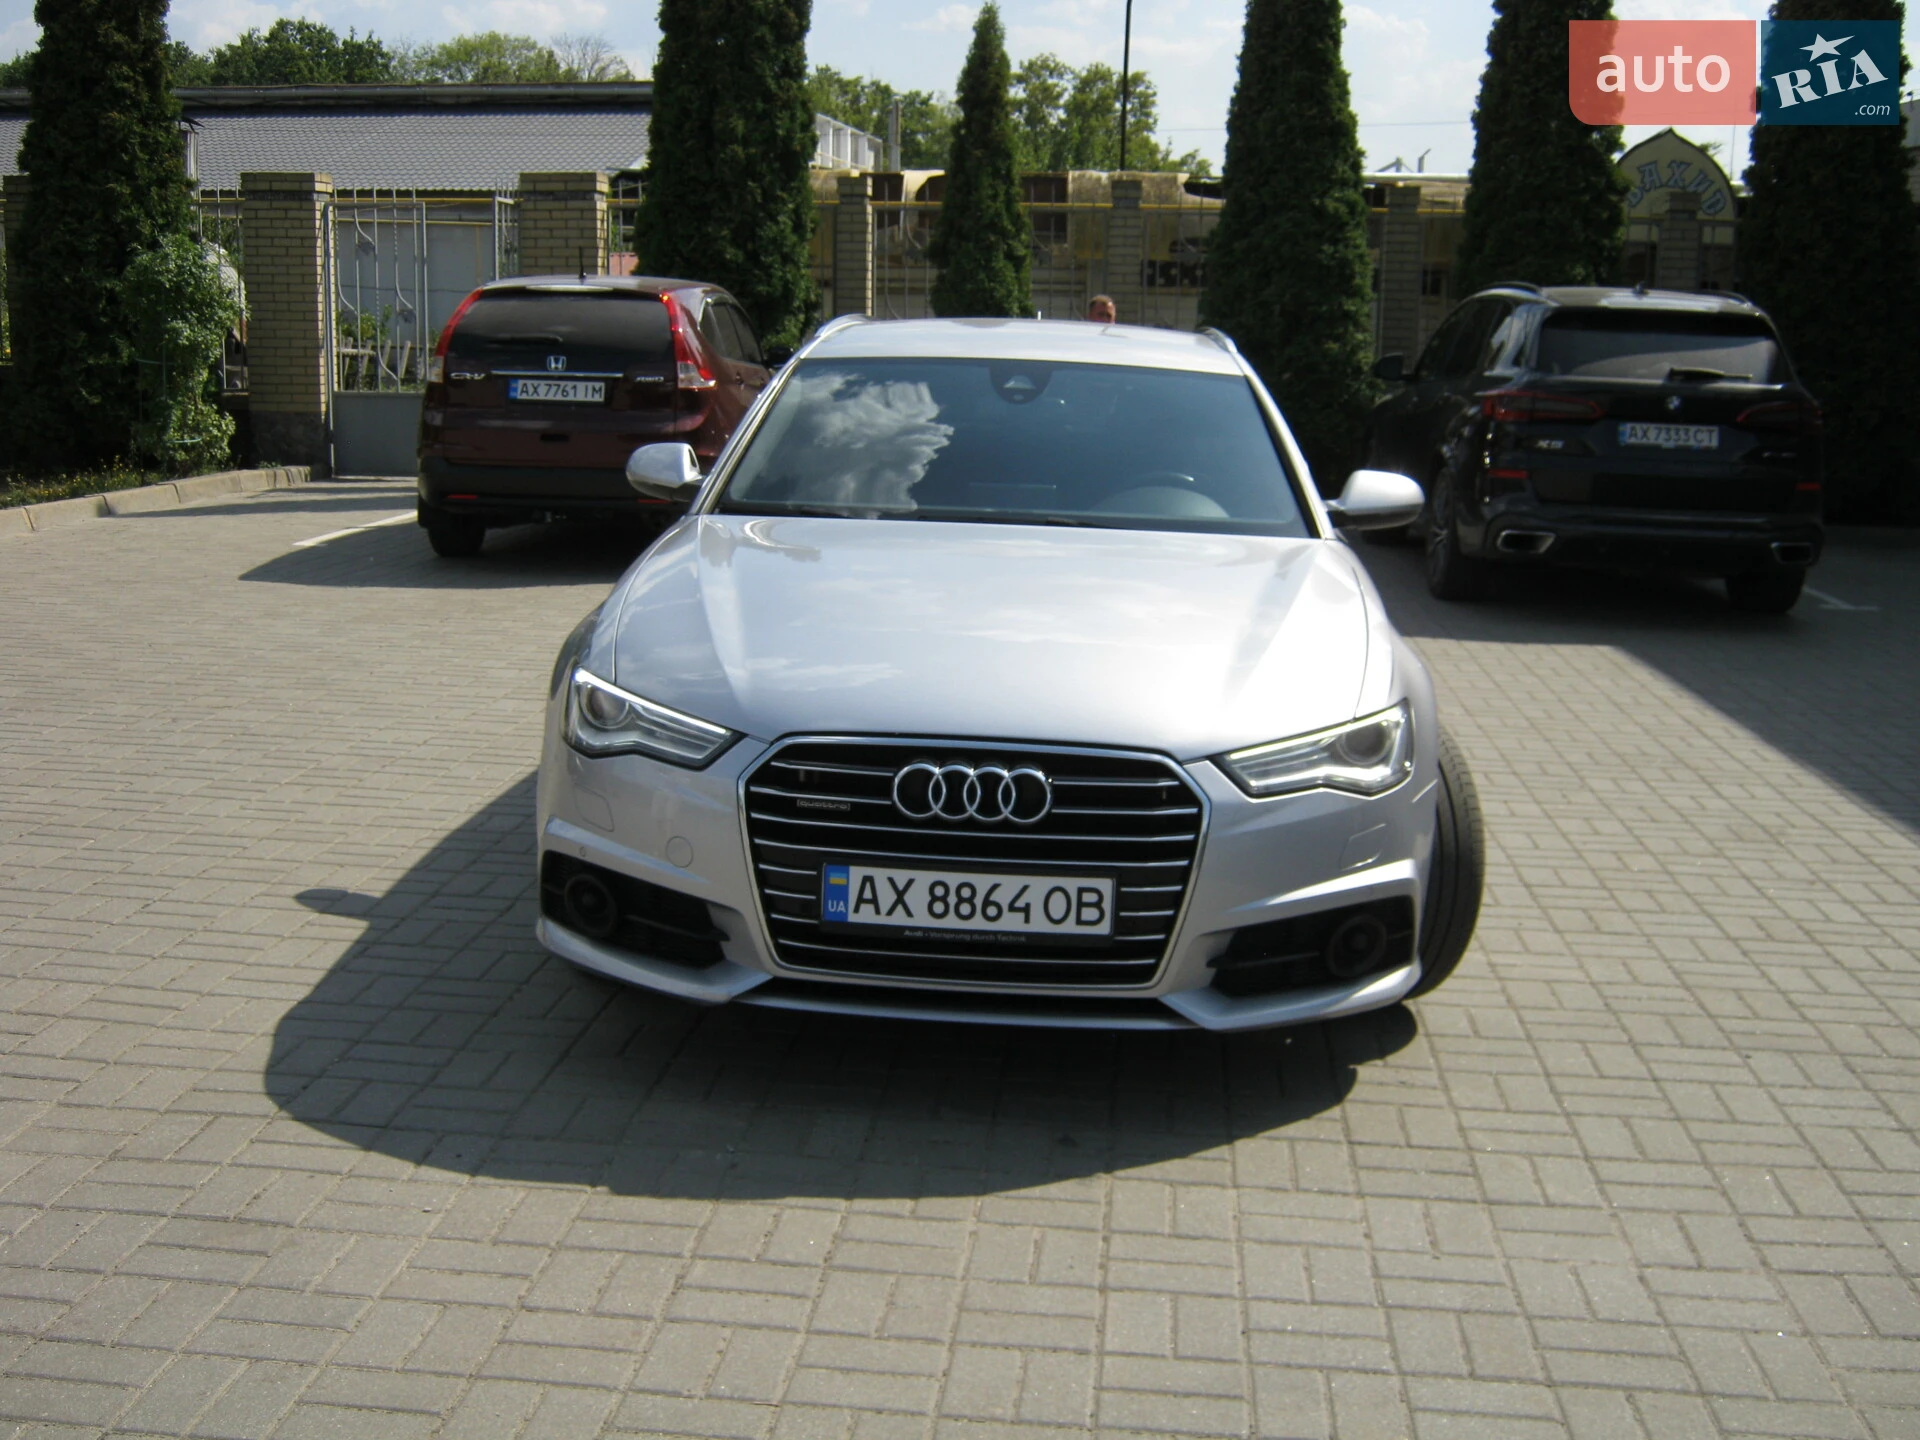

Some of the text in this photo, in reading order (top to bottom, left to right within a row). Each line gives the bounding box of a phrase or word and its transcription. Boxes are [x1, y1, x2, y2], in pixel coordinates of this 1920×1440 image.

[519, 382, 541, 397] AX
[544, 383, 578, 398] 7761
[584, 384, 603, 399] IM
[1628, 424, 1717, 444] AX 7333 CT
[828, 900, 847, 913] UA
[853, 875, 1106, 926] AX 8864 OB
